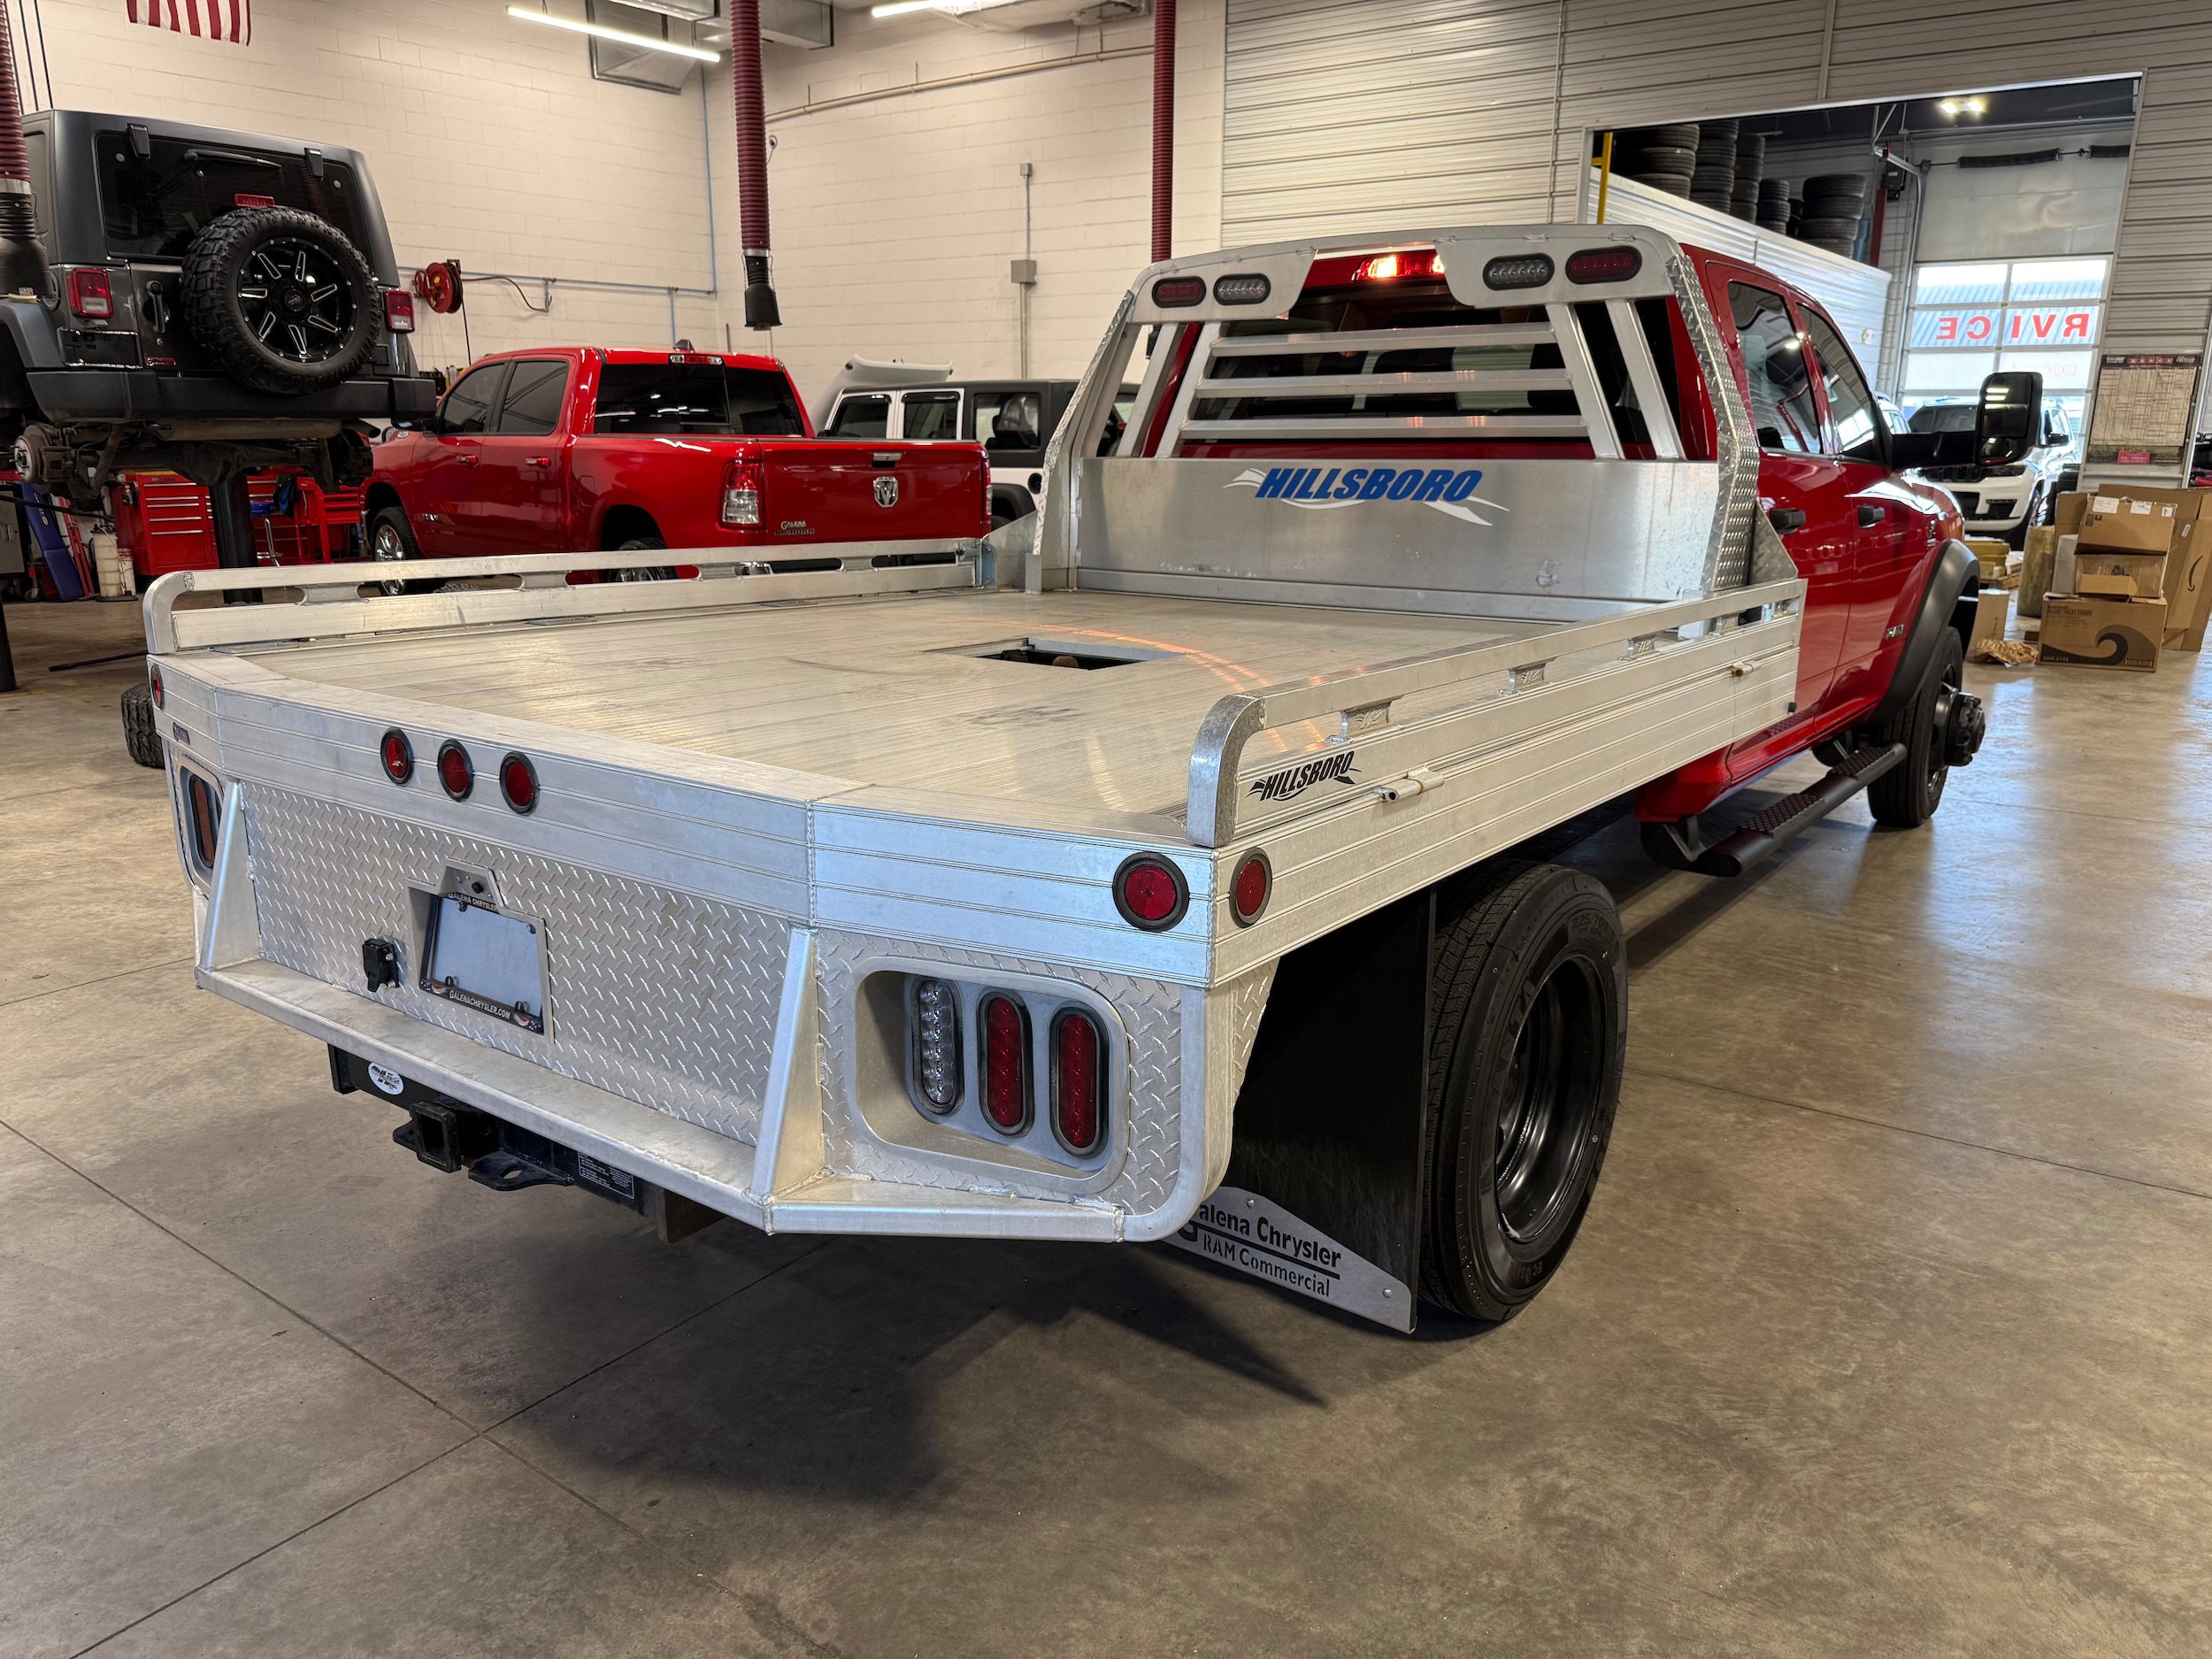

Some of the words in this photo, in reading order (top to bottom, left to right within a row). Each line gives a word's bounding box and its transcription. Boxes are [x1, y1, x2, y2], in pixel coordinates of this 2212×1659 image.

[1255, 468, 1483, 503] HILLSBORO
[1260, 750, 1355, 802] HILLSBORO
[448, 893, 471, 904] GALENA
[449, 989, 511, 1019] GALENACHRYSLER.COM
[1256, 1217, 1341, 1268] Chrysler
[1203, 1233, 1235, 1261] RAM
[1240, 1248, 1331, 1297] Commercial
